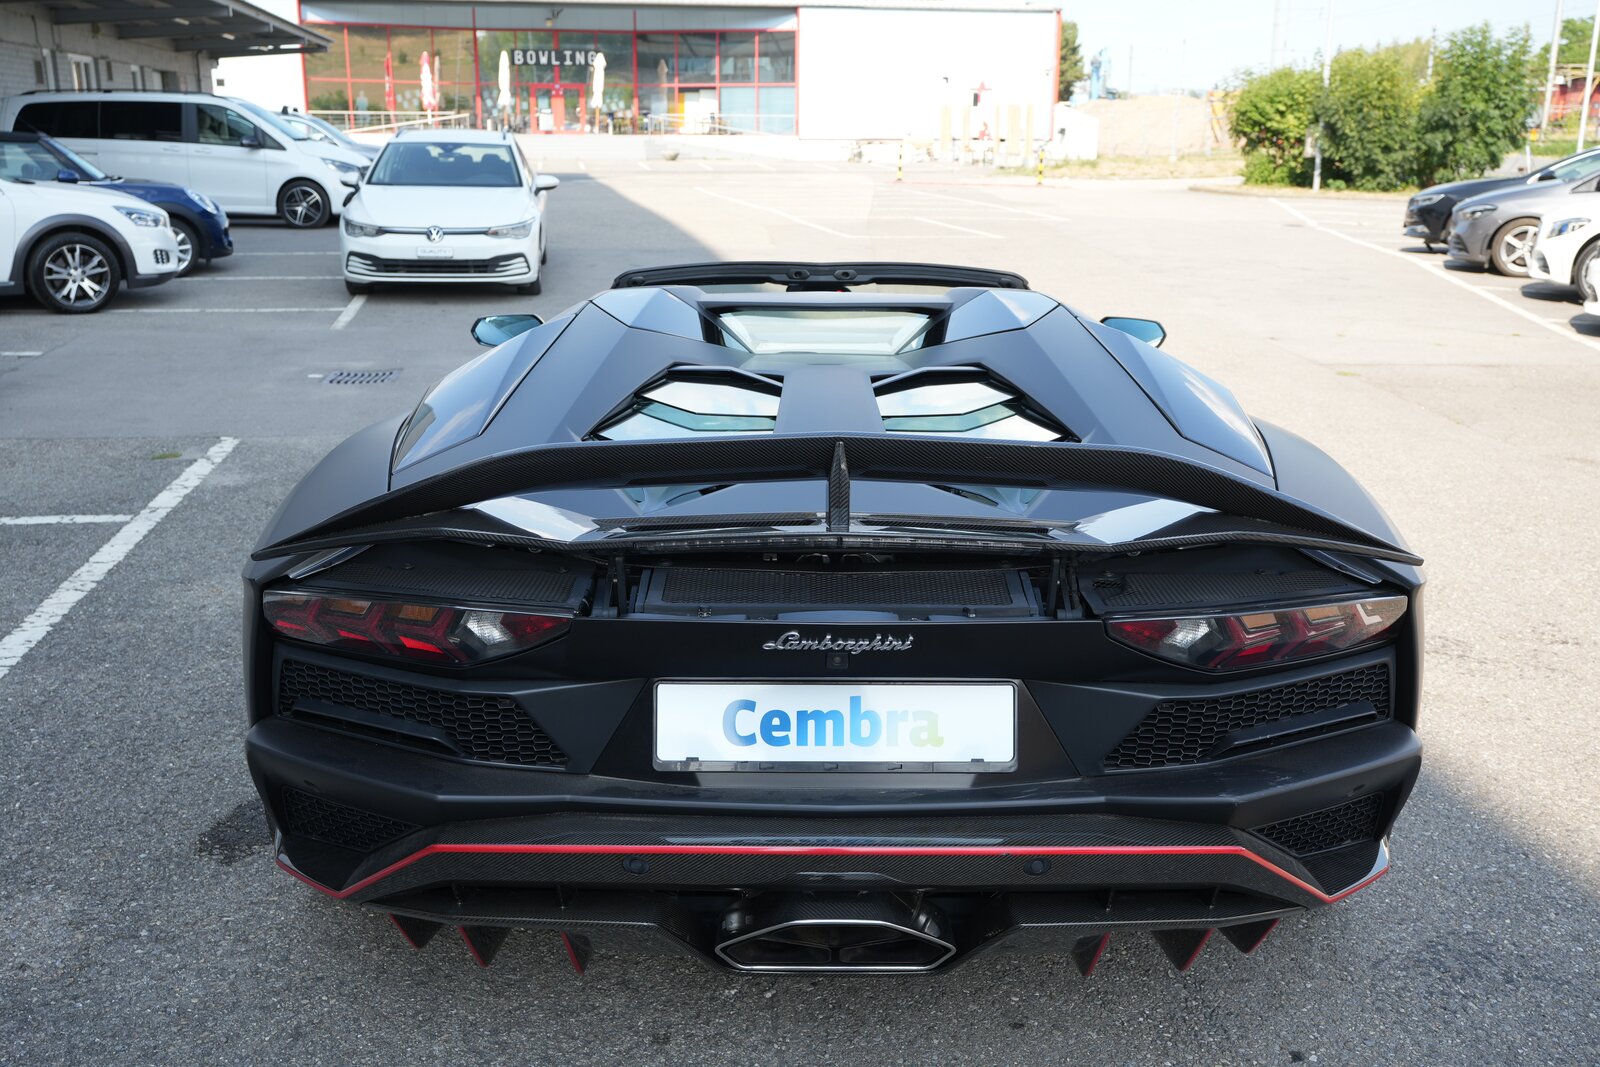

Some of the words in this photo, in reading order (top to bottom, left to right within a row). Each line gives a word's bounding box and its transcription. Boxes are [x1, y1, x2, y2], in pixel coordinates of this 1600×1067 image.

[513, 50, 597, 65] BOWLING
[762, 630, 914, 655] Lamborghini
[722, 696, 944, 747] Cembra
